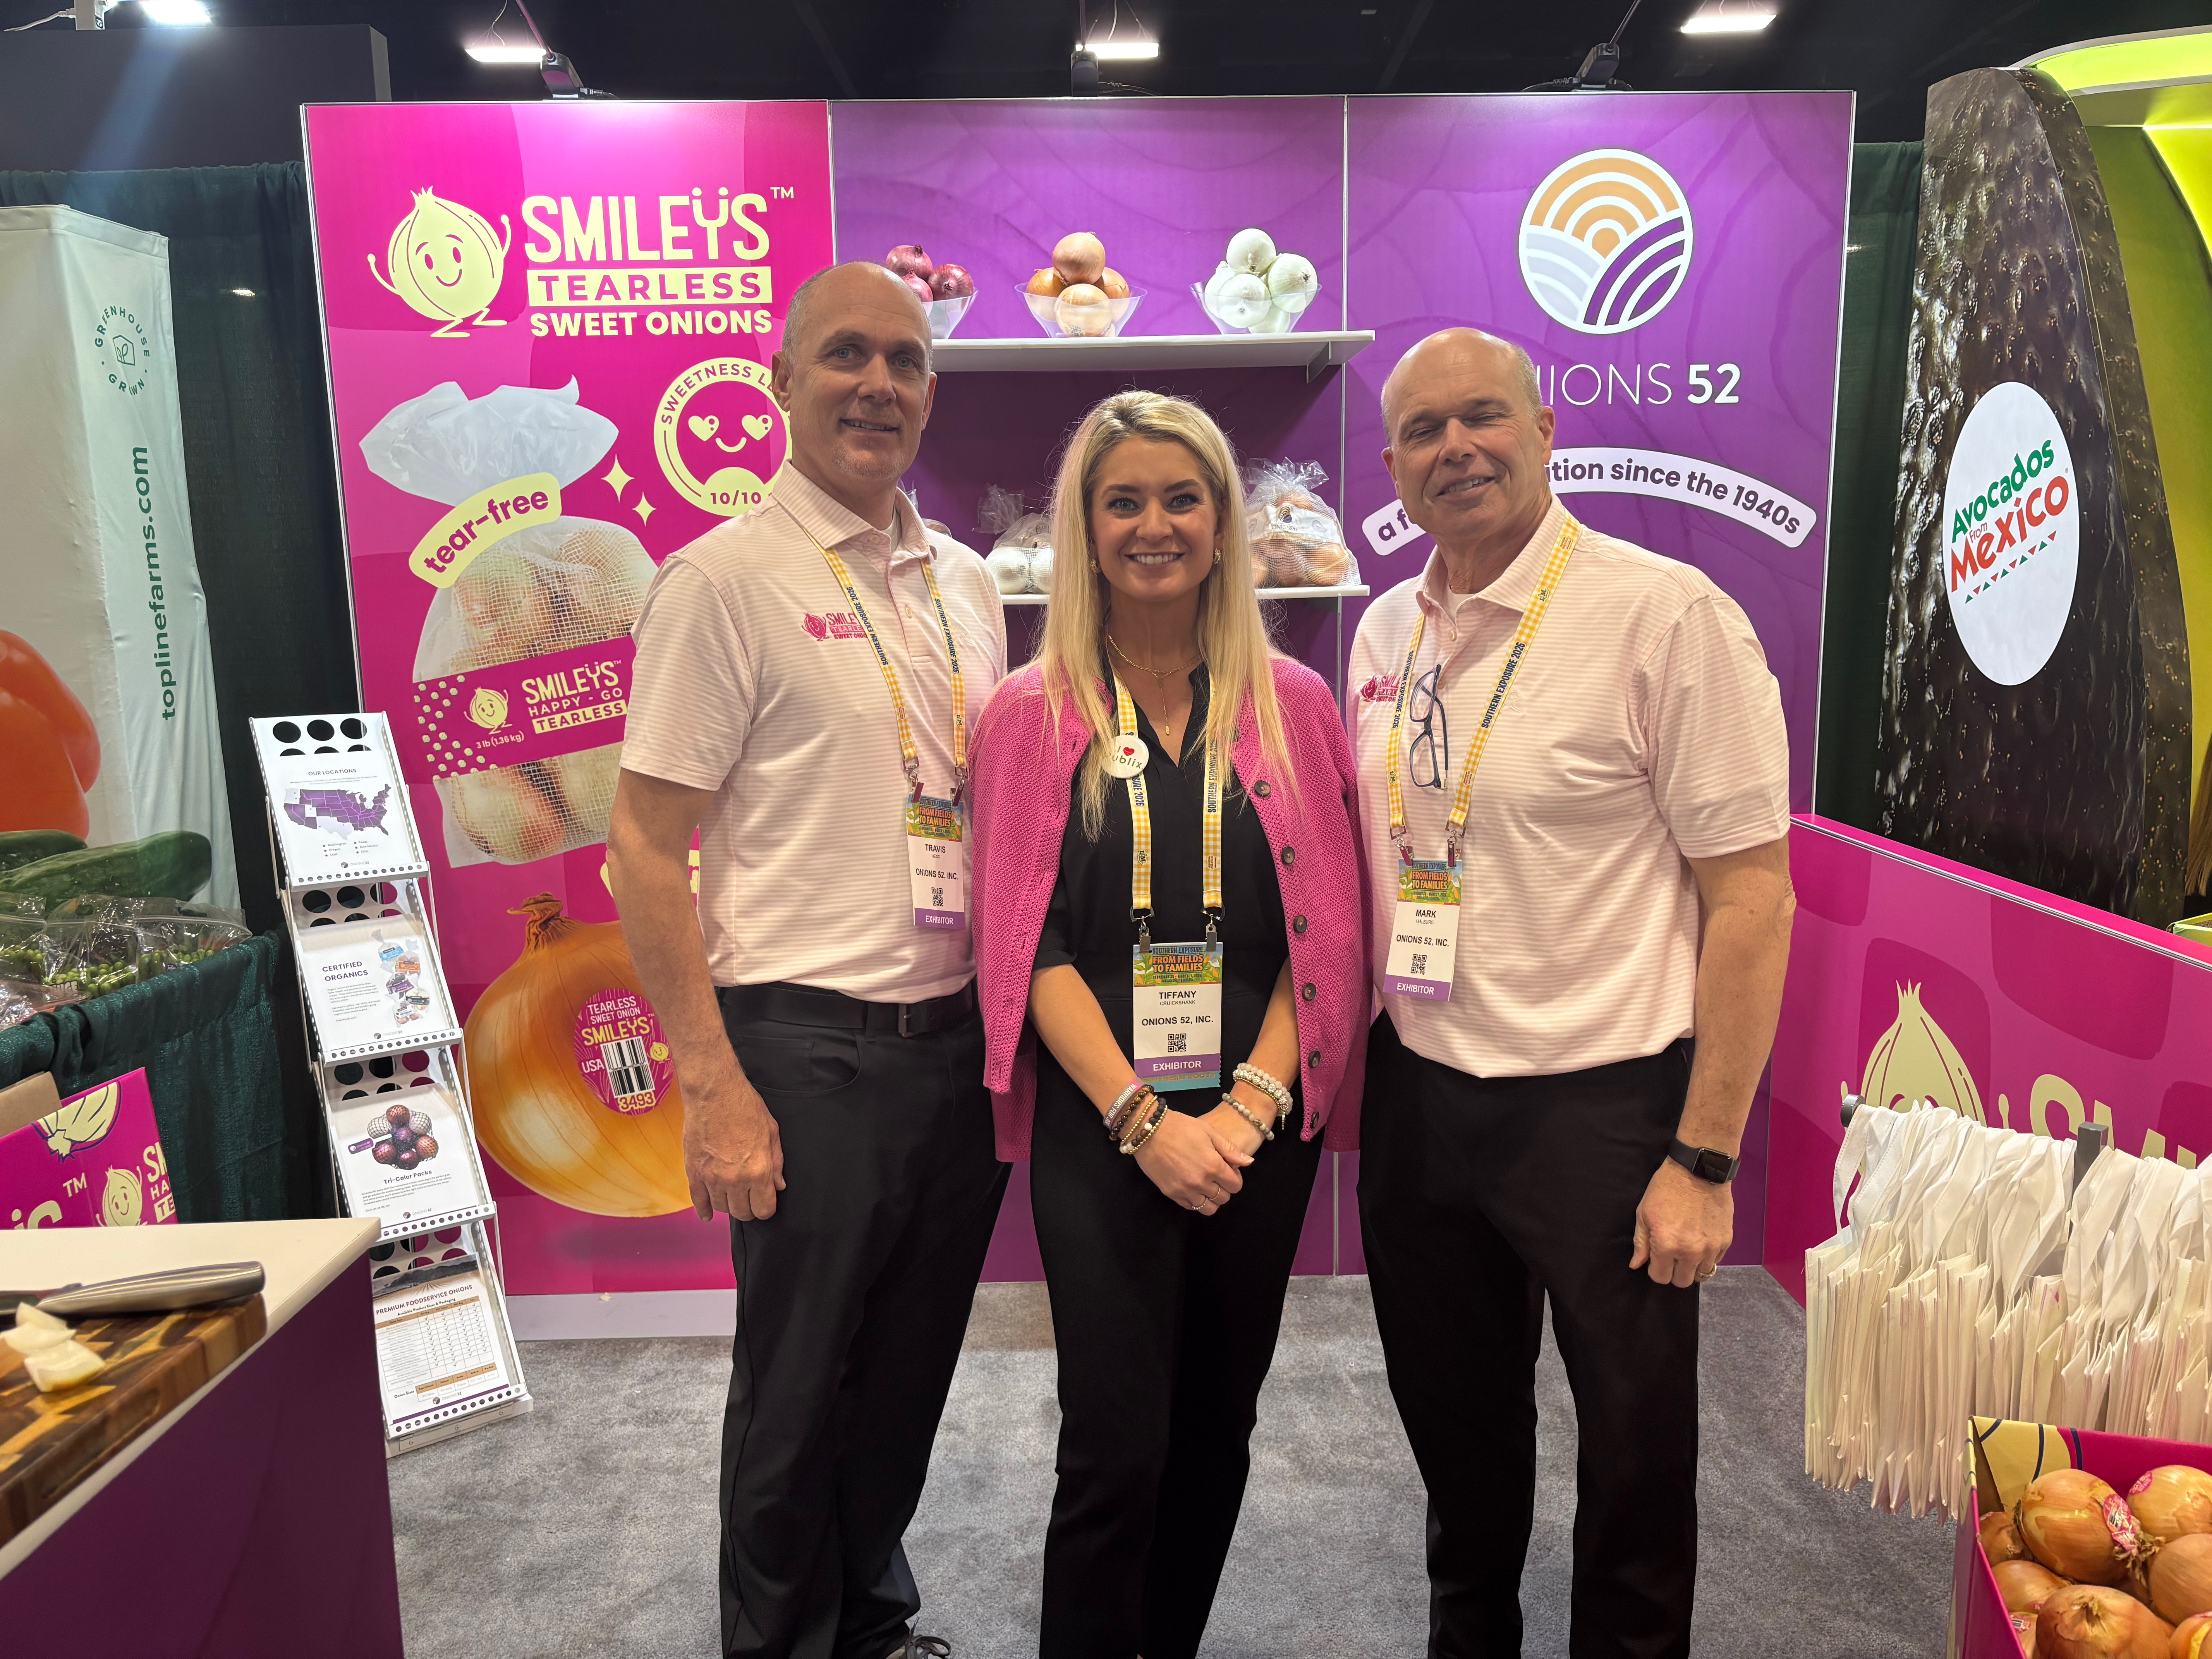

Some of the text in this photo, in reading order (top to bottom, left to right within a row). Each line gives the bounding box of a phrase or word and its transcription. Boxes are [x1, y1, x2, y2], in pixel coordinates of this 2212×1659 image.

[538, 274, 762, 301] TEARLESS
[94, 306, 149, 357] GREENHOUSE
[531, 309, 772, 336] SWEET ONIONS
[109, 374, 144, 395] GRWN
[1687, 363, 1740, 404] 52
[661, 364, 752, 424] SWEETNESS
[710, 490, 761, 506] 10/10
[1611, 458, 1681, 488] since
[1686, 470, 1728, 501] the
[1733, 484, 1801, 534] 1940s
[1953, 440, 2055, 543] Avocados
[424, 488, 549, 574] tear-free
[1378, 524, 1395, 542] a
[1951, 476, 2069, 592] Mexico
[1969, 522, 1987, 543] From
[133, 447, 176, 720] toplinefarms.com
[826, 612, 858, 625] SMILE
[847, 586, 888, 665] SOUTHERN EXPOSURE 2026
[935, 599, 959, 673] SOUTHERN EXPOSURE 2026
[1392, 651, 1414, 729] SOUTHERN EXPOSURE 2026
[1481, 642, 1525, 728] SOUTHERN EXPOSURE 2026
[528, 697, 580, 717] HAPPY
[601, 688, 623, 701] GO
[536, 702, 625, 731] TEARLESS
[1134, 792, 1144, 806] 2026
[1208, 782, 1217, 813] SOUTHERN
[919, 815, 951, 827] TO FAMILIES
[920, 807, 951, 818] FROM FIELDS
[925, 844, 946, 853] TRAVIS
[916, 869, 936, 878] ONIONS
[1412, 872, 1447, 880] FROM FIELDS
[1412, 880, 1447, 890] TO FAMILIES
[926, 915, 953, 925] EXHIBITOR
[1416, 910, 1436, 918] MARK
[1396, 935, 1449, 946] ONIONS 52, INC.
[322, 962, 362, 972] CERTIFIED
[325, 970, 368, 981] ORGANICS
[1165, 963, 1203, 972] FAMILIES
[1159, 991, 1196, 999] TIFFANY
[1397, 982, 1434, 994] EXHIBITOR
[587, 996, 637, 1014] TEARLESS
[591, 1007, 641, 1024] SWEET ONION
[1142, 1017, 1177, 1026] ONIONS
[582, 1059, 604, 1073] USA
[1153, 1061, 1201, 1071] EXHIBITOR
[620, 1093, 655, 1109] 3493
[1108, 1084, 1137, 1118] WARRIORS FOR
[63, 1173, 87, 1197] TM
[384, 1175, 412, 1184] Tri-Color
[376, 1285, 472, 1315] PREMIUM FOODSERVICE ONIONS
